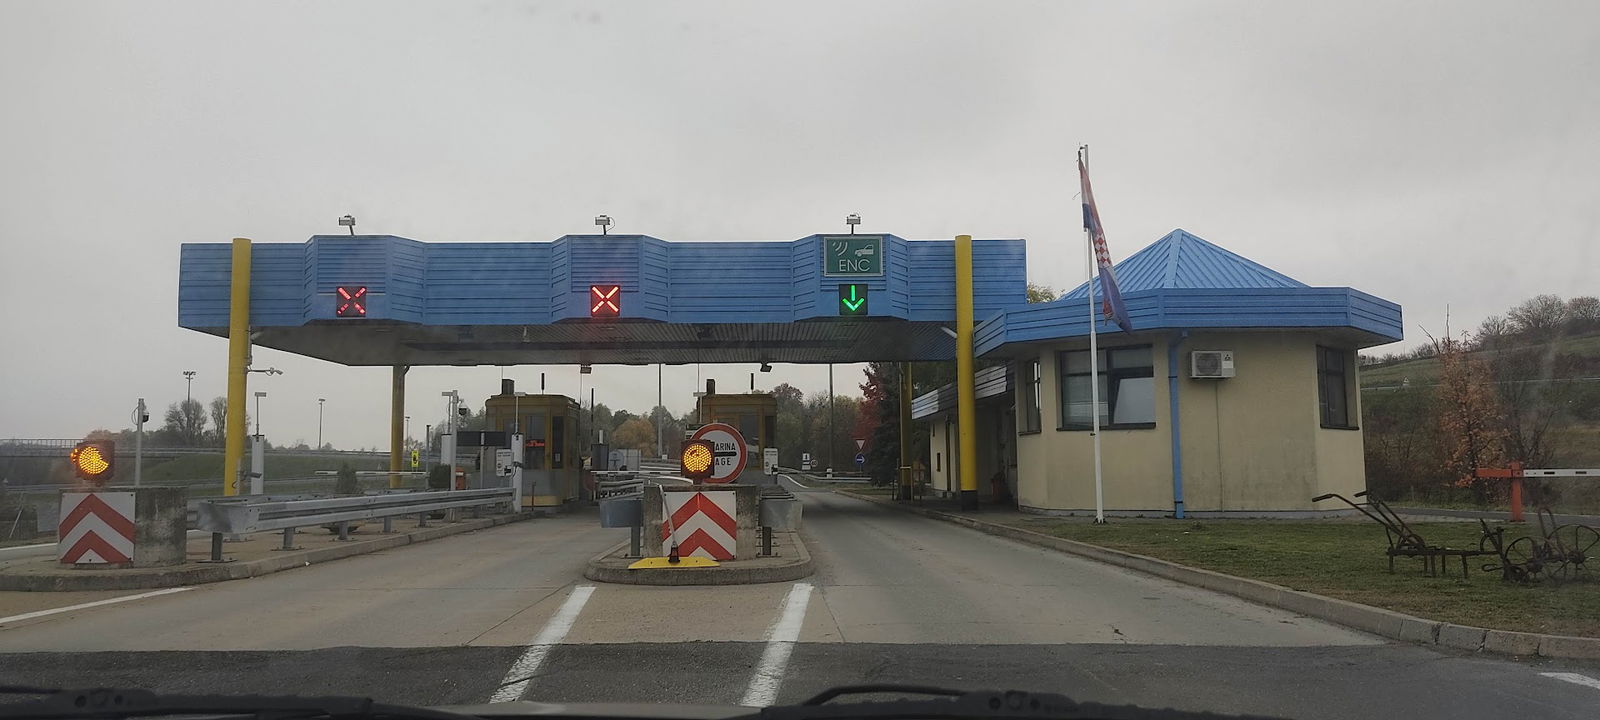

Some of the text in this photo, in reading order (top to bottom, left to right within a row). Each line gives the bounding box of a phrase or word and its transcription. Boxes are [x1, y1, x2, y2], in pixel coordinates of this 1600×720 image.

[839, 259, 870, 272] ENC
[715, 442, 736, 451] ARINA
[715, 457, 732, 466] AGE
